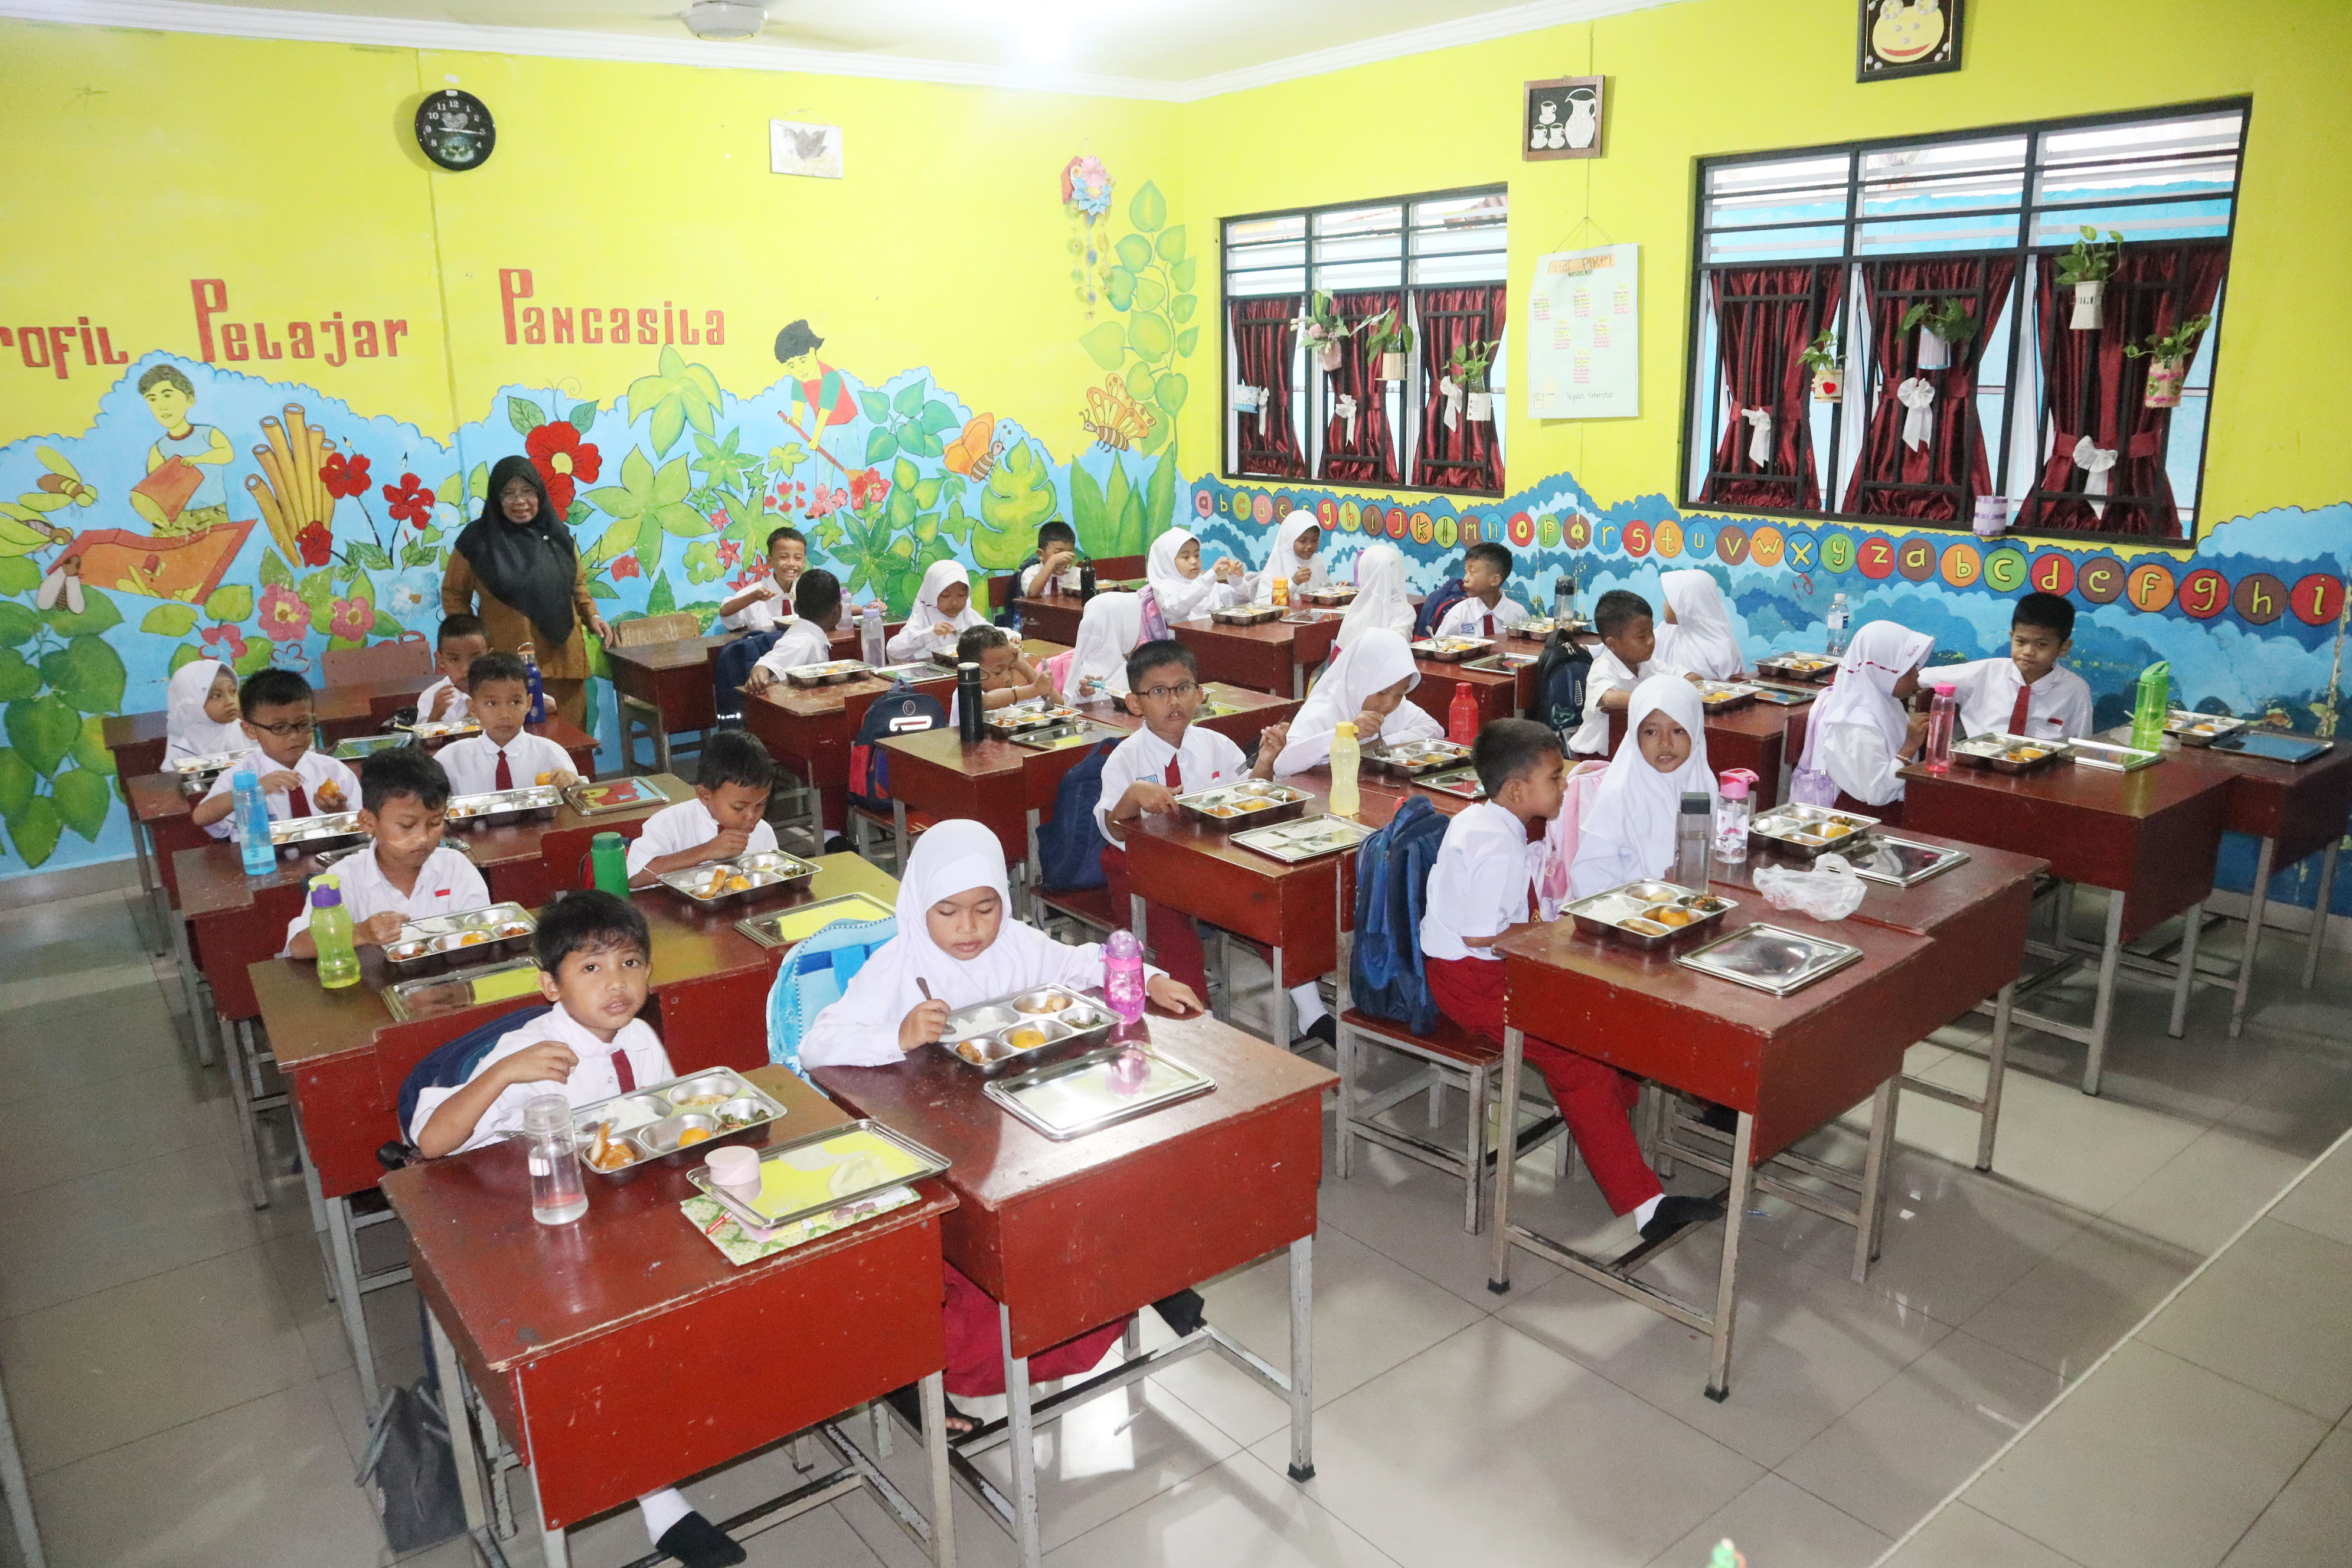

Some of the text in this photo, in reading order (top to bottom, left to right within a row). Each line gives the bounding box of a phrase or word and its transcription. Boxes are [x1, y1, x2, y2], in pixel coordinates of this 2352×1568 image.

[437, 102, 446, 111] 11
[427, 112, 439, 120] 10
[431, 139, 437, 147] 8
[190, 279, 407, 367] Pelajar
[499, 269, 724, 345] Pancasila
[1201, 497, 1208, 509] a
[1220, 494, 1228, 512] b
[1237, 499, 1245, 512] c
[1259, 503, 1266, 517] d
[1279, 504, 1286, 518] e
[1323, 503, 1331, 525] g
[1346, 503, 1355, 526] h
[1371, 508, 1374, 530] i
[1417, 511, 1427, 539] k
[1465, 522, 1477, 540] m
[1488, 521, 1498, 539] n
[1544, 520, 1554, 543] p
[1602, 525, 1615, 546] r
[1661, 528, 1674, 552] t
[1694, 533, 1704, 548] u
[1725, 537, 1742, 556] v
[1757, 537, 1781, 554] w
[1791, 541, 1812, 566] x
[1832, 540, 1846, 566] y
[1871, 545, 1888, 563] z
[1906, 548, 1926, 568] a
[1956, 551, 1972, 578] b
[1993, 558, 2013, 581] c
[2041, 560, 2059, 590] d
[2089, 570, 2111, 592] e
[2141, 573, 2161, 605] f
[2191, 577, 2217, 611] g
[2253, 582, 2272, 615] h
[2314, 577, 2326, 616] i
